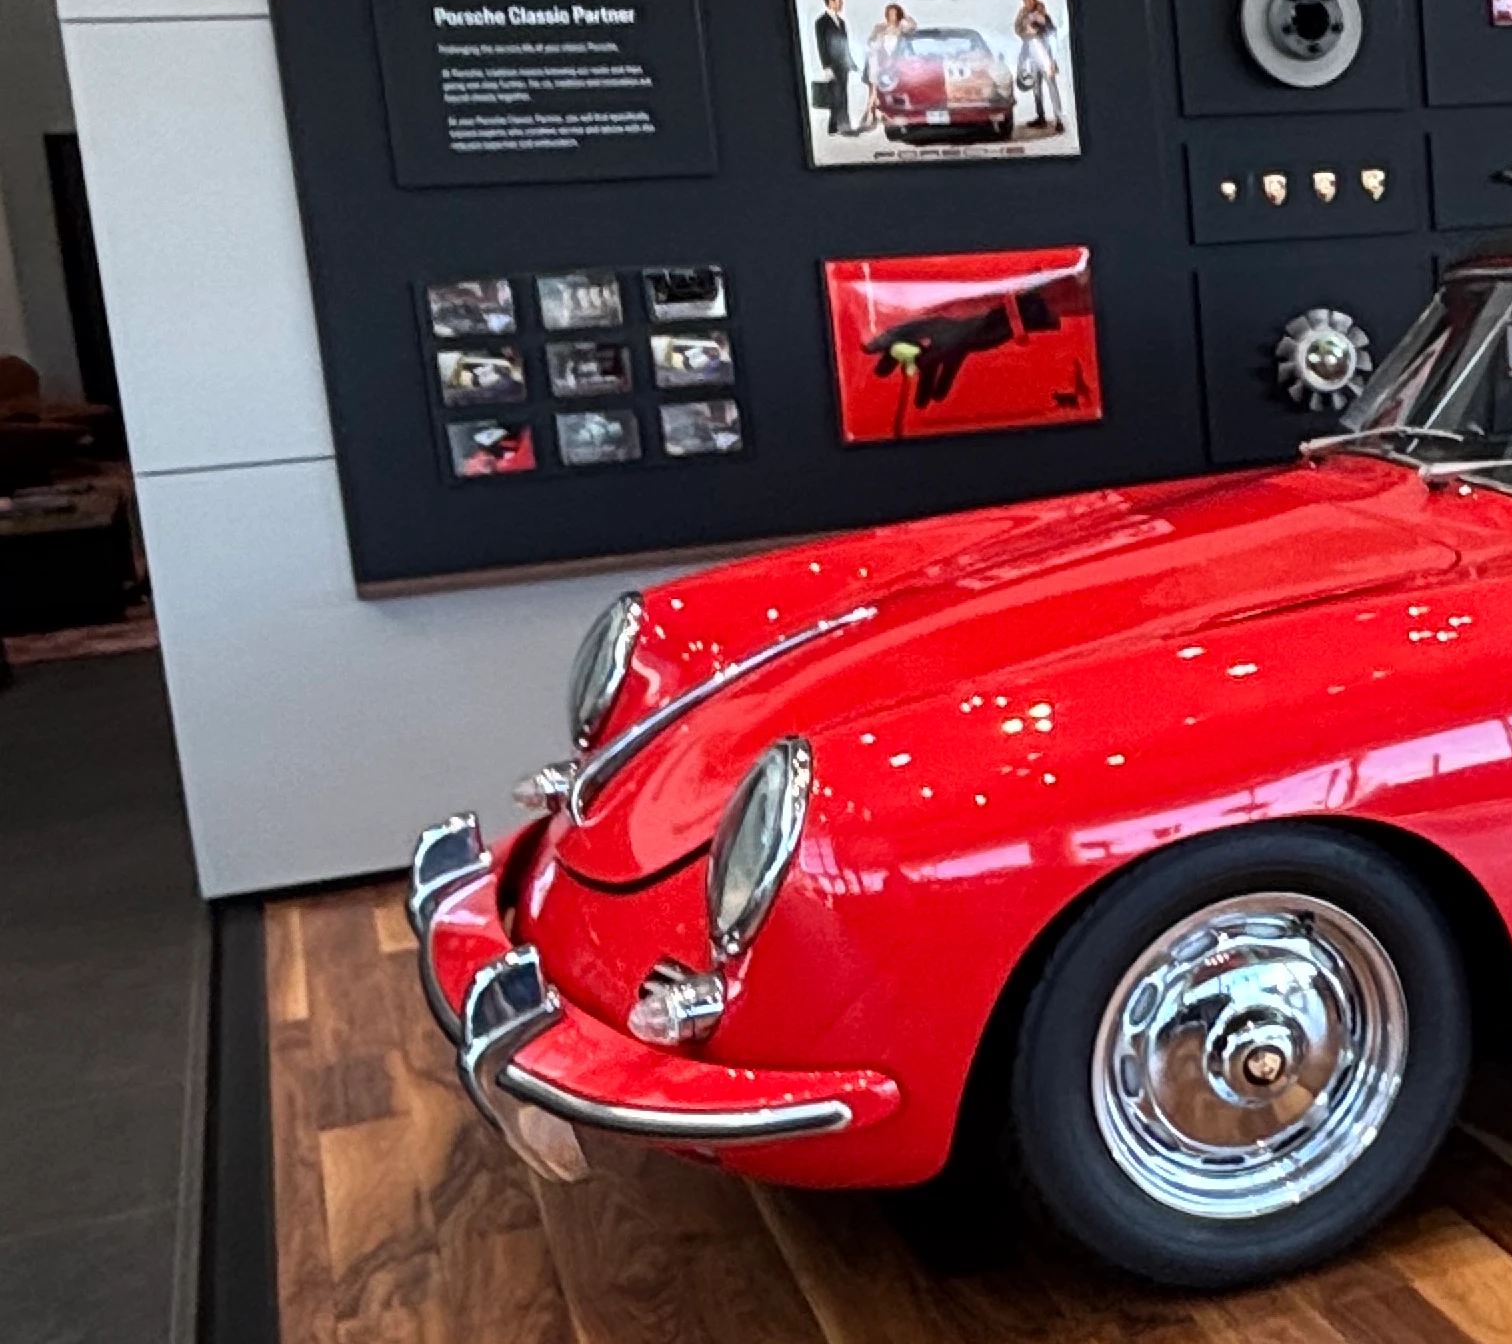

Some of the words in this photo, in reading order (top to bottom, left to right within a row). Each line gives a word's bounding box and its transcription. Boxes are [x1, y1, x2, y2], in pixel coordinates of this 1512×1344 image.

[433, 6, 506, 27] Porsche
[508, 5, 570, 25] Classic
[572, 5, 636, 24] Partner
